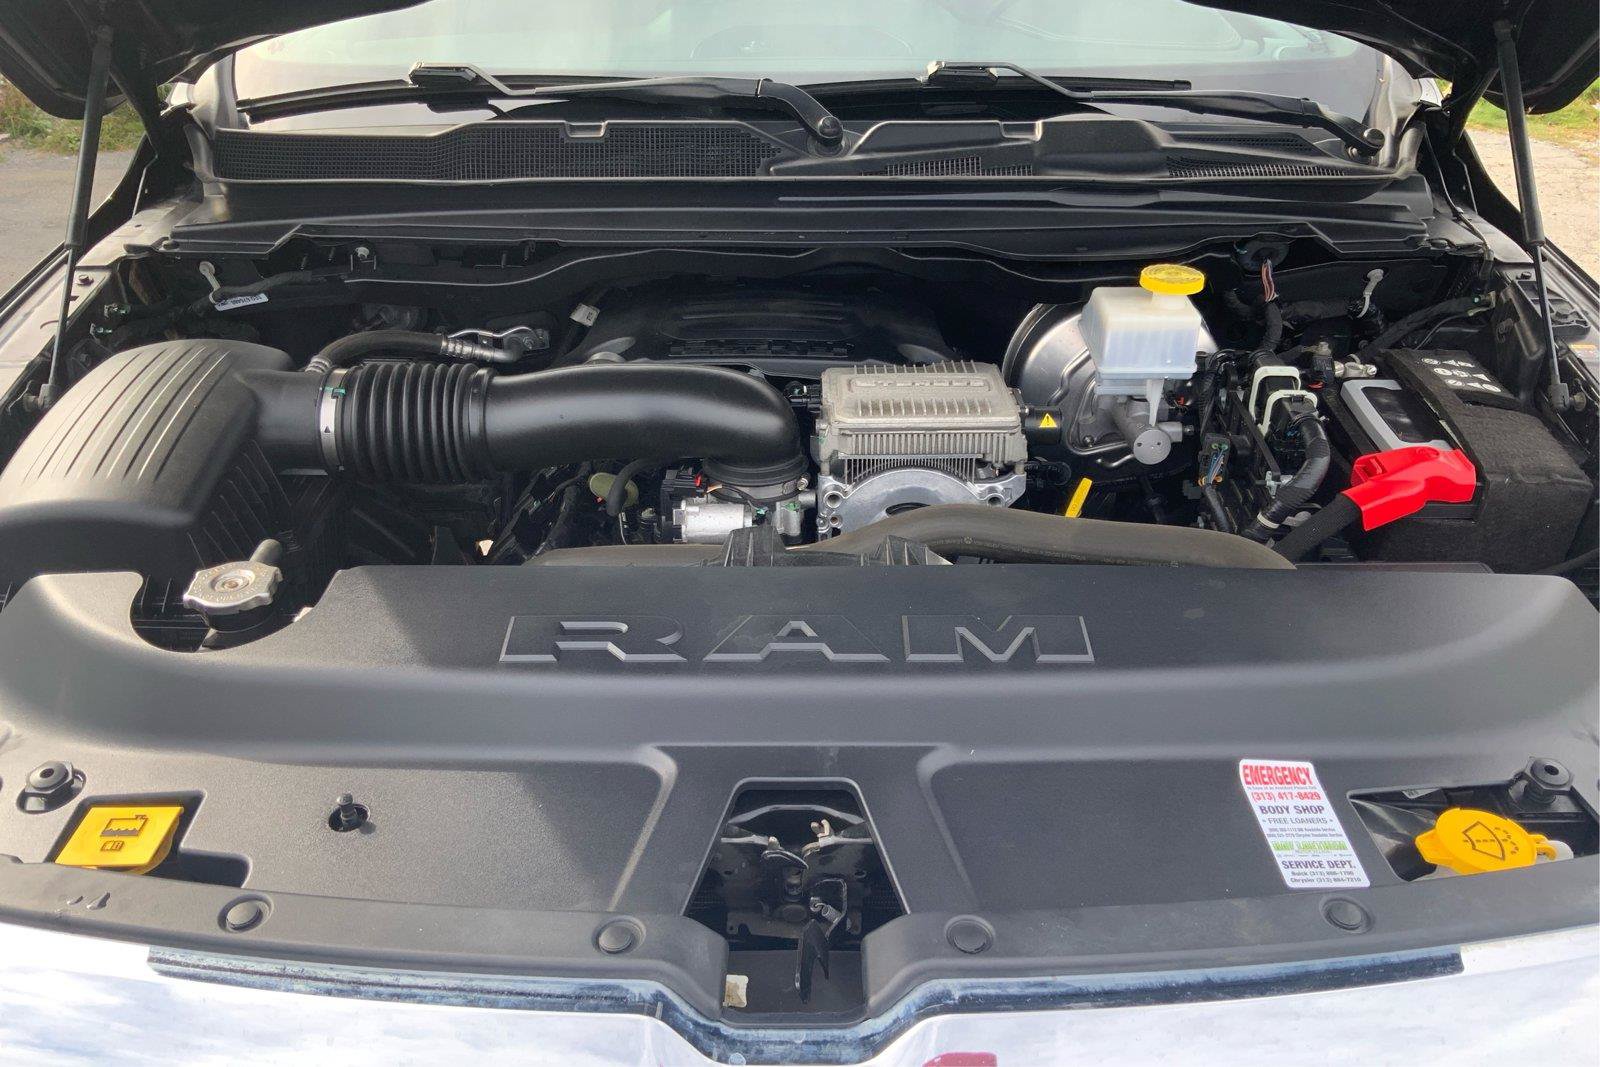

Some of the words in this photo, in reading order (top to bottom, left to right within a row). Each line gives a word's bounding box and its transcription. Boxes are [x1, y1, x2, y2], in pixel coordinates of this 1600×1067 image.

[499, 614, 1094, 663] RAM
[1242, 764, 1314, 786] EMERGENCY
[1251, 791, 1276, 802] (313)
[1278, 790, 1321, 801] 417-8429
[1259, 805, 1290, 815] BODY
[1293, 805, 1325, 814] SHOP
[1267, 817, 1290, 825] FREE
[1291, 817, 1328, 825] LOANERS
[1281, 860, 1325, 870] SERVICE
[1328, 860, 1357, 869] DEPT.
